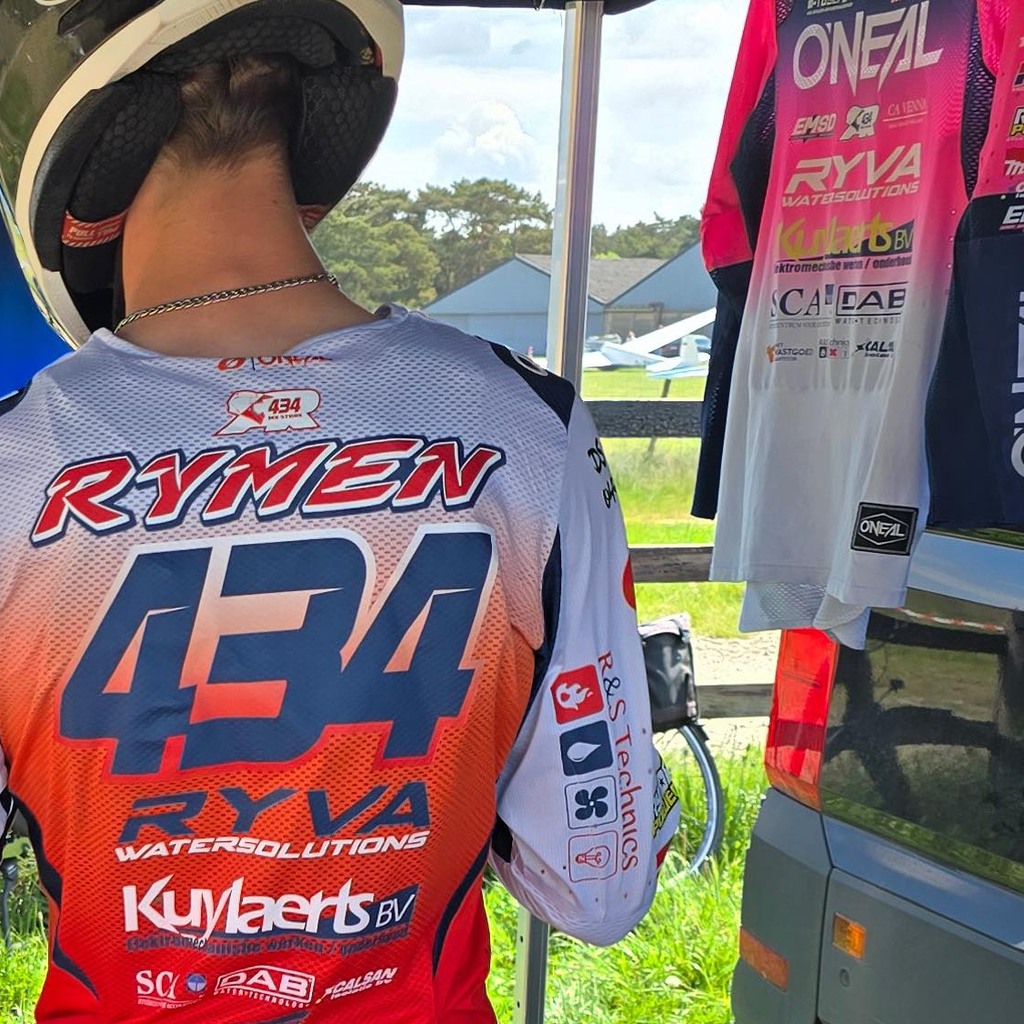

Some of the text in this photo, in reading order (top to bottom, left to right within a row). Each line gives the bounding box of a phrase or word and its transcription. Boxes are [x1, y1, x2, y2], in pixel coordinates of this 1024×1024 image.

[785, 143, 921, 193] RYVA
[268, 398, 301, 415] 434
[30, 437, 506, 547] RYMEN
[58, 526, 496, 780] 434
[119, 781, 431, 843] RYVA
[615, 725, 643, 872] Technics
[114, 830, 430, 863] WATERSOLUTIONS
[122, 875, 415, 942] Kuylaerts BV
[219, 969, 309, 998] DAB
